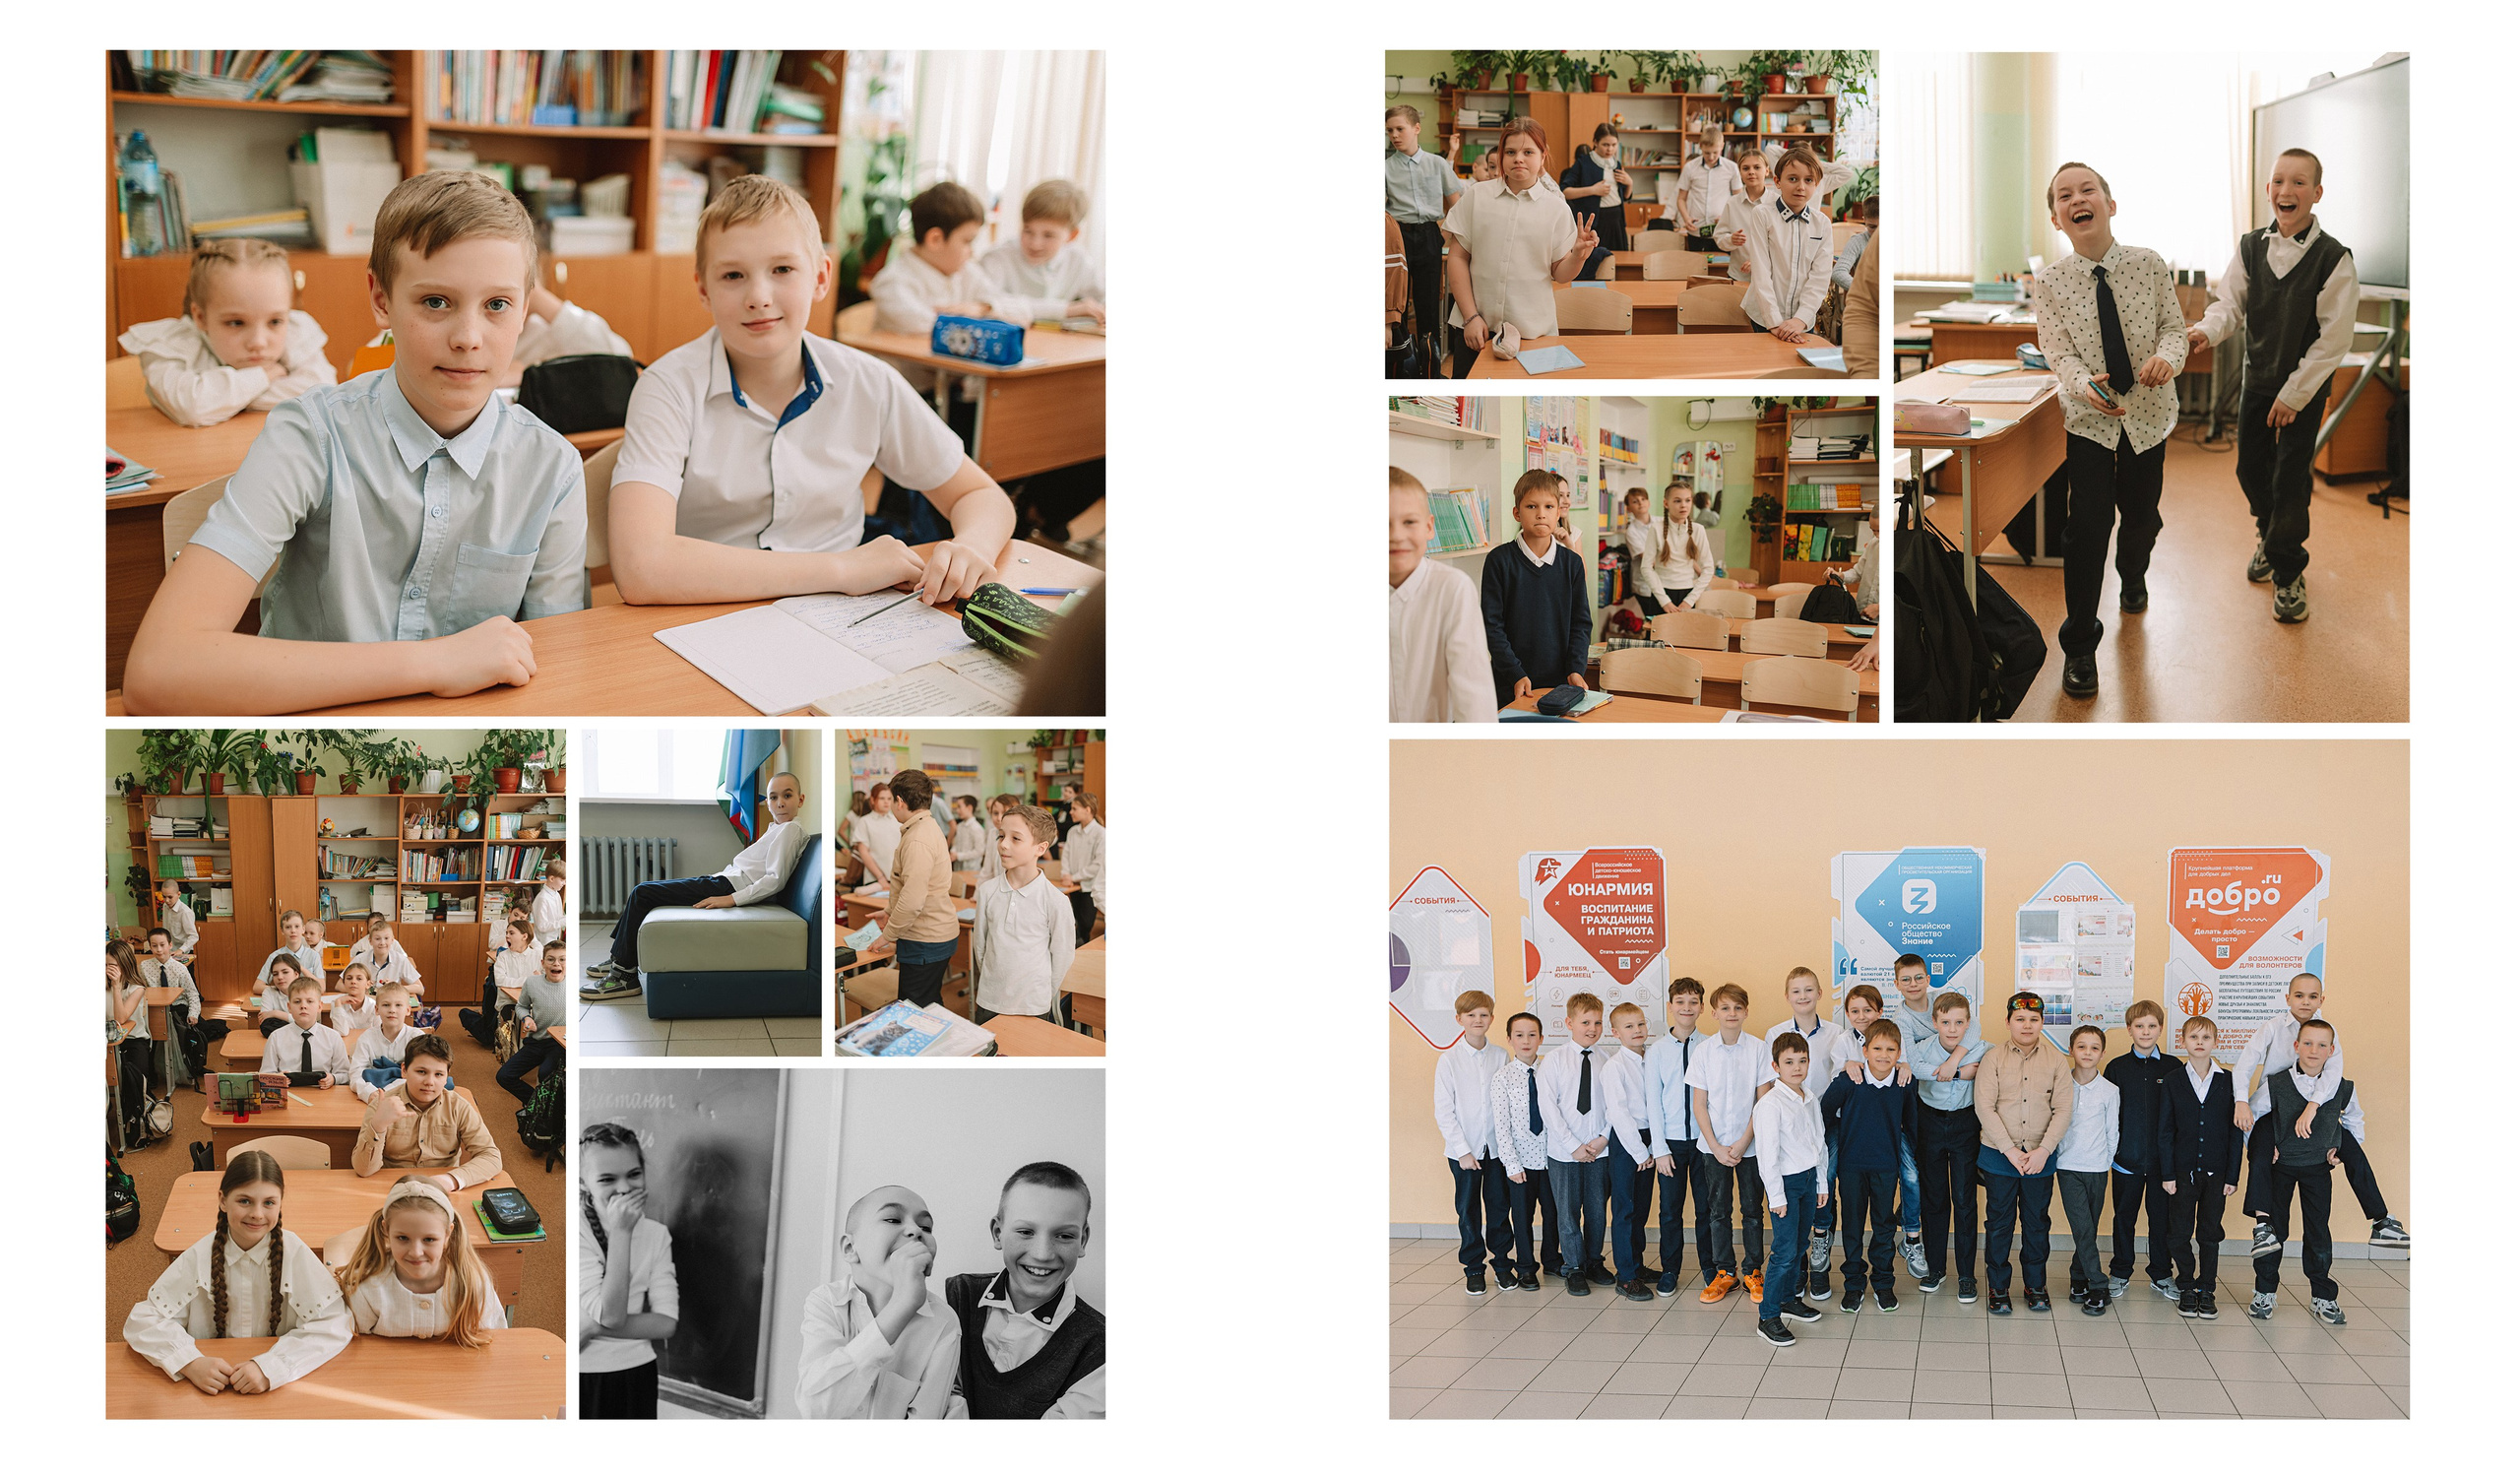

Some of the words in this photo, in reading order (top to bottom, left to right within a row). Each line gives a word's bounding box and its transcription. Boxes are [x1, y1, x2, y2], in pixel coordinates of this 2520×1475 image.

[2261, 874, 2282, 884] .ru
[1568, 882, 1654, 896] ЮНАРМИЯ
[2052, 894, 2099, 903] СОБЫТИЯ
[2185, 880, 2281, 912] добро
[1581, 904, 1654, 914] ВОСПИТАНИЕ
[1581, 915, 1654, 926] ГРАЖДАНИНА
[1587, 927, 1596, 935] И
[1598, 927, 1655, 935] ПАТРИОТА
[1901, 936, 1934, 945] Знание
